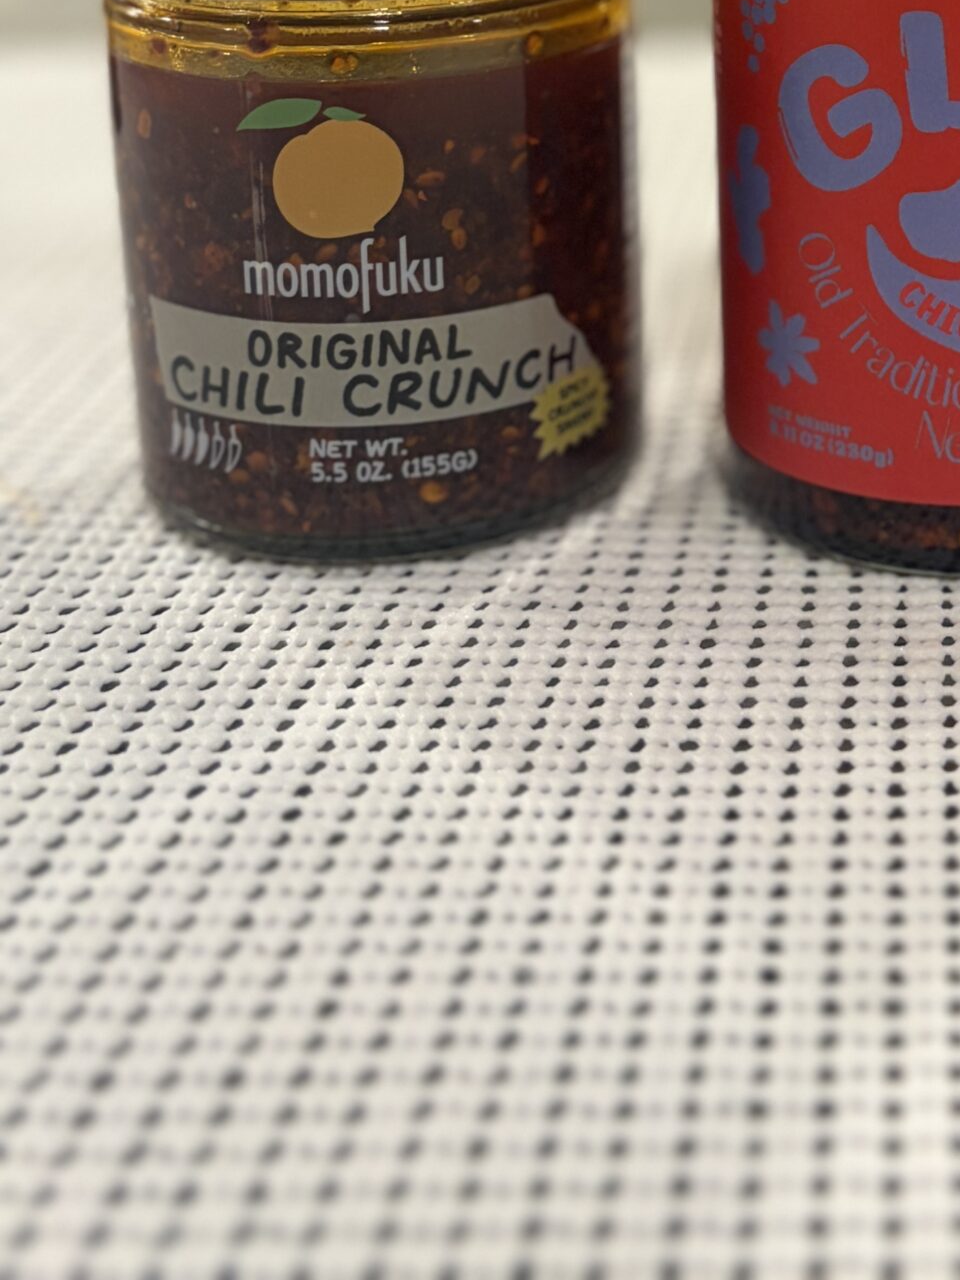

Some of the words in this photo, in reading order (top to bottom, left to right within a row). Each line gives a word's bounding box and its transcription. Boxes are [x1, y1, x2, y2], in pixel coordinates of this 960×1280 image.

[243, 235, 445, 315] momofuku
[798, 231, 854, 310] Old
[171, 354, 305, 418] CHILI
[342, 334, 576, 418] CRUNCH
[247, 323, 473, 371] ORIGINAL
[309, 437, 358, 459] NET
[365, 436, 408, 458] WT.
[312, 461, 348, 483] 5.5
[356, 460, 393, 483] OZ.
[402, 447, 479, 479] (155G)
